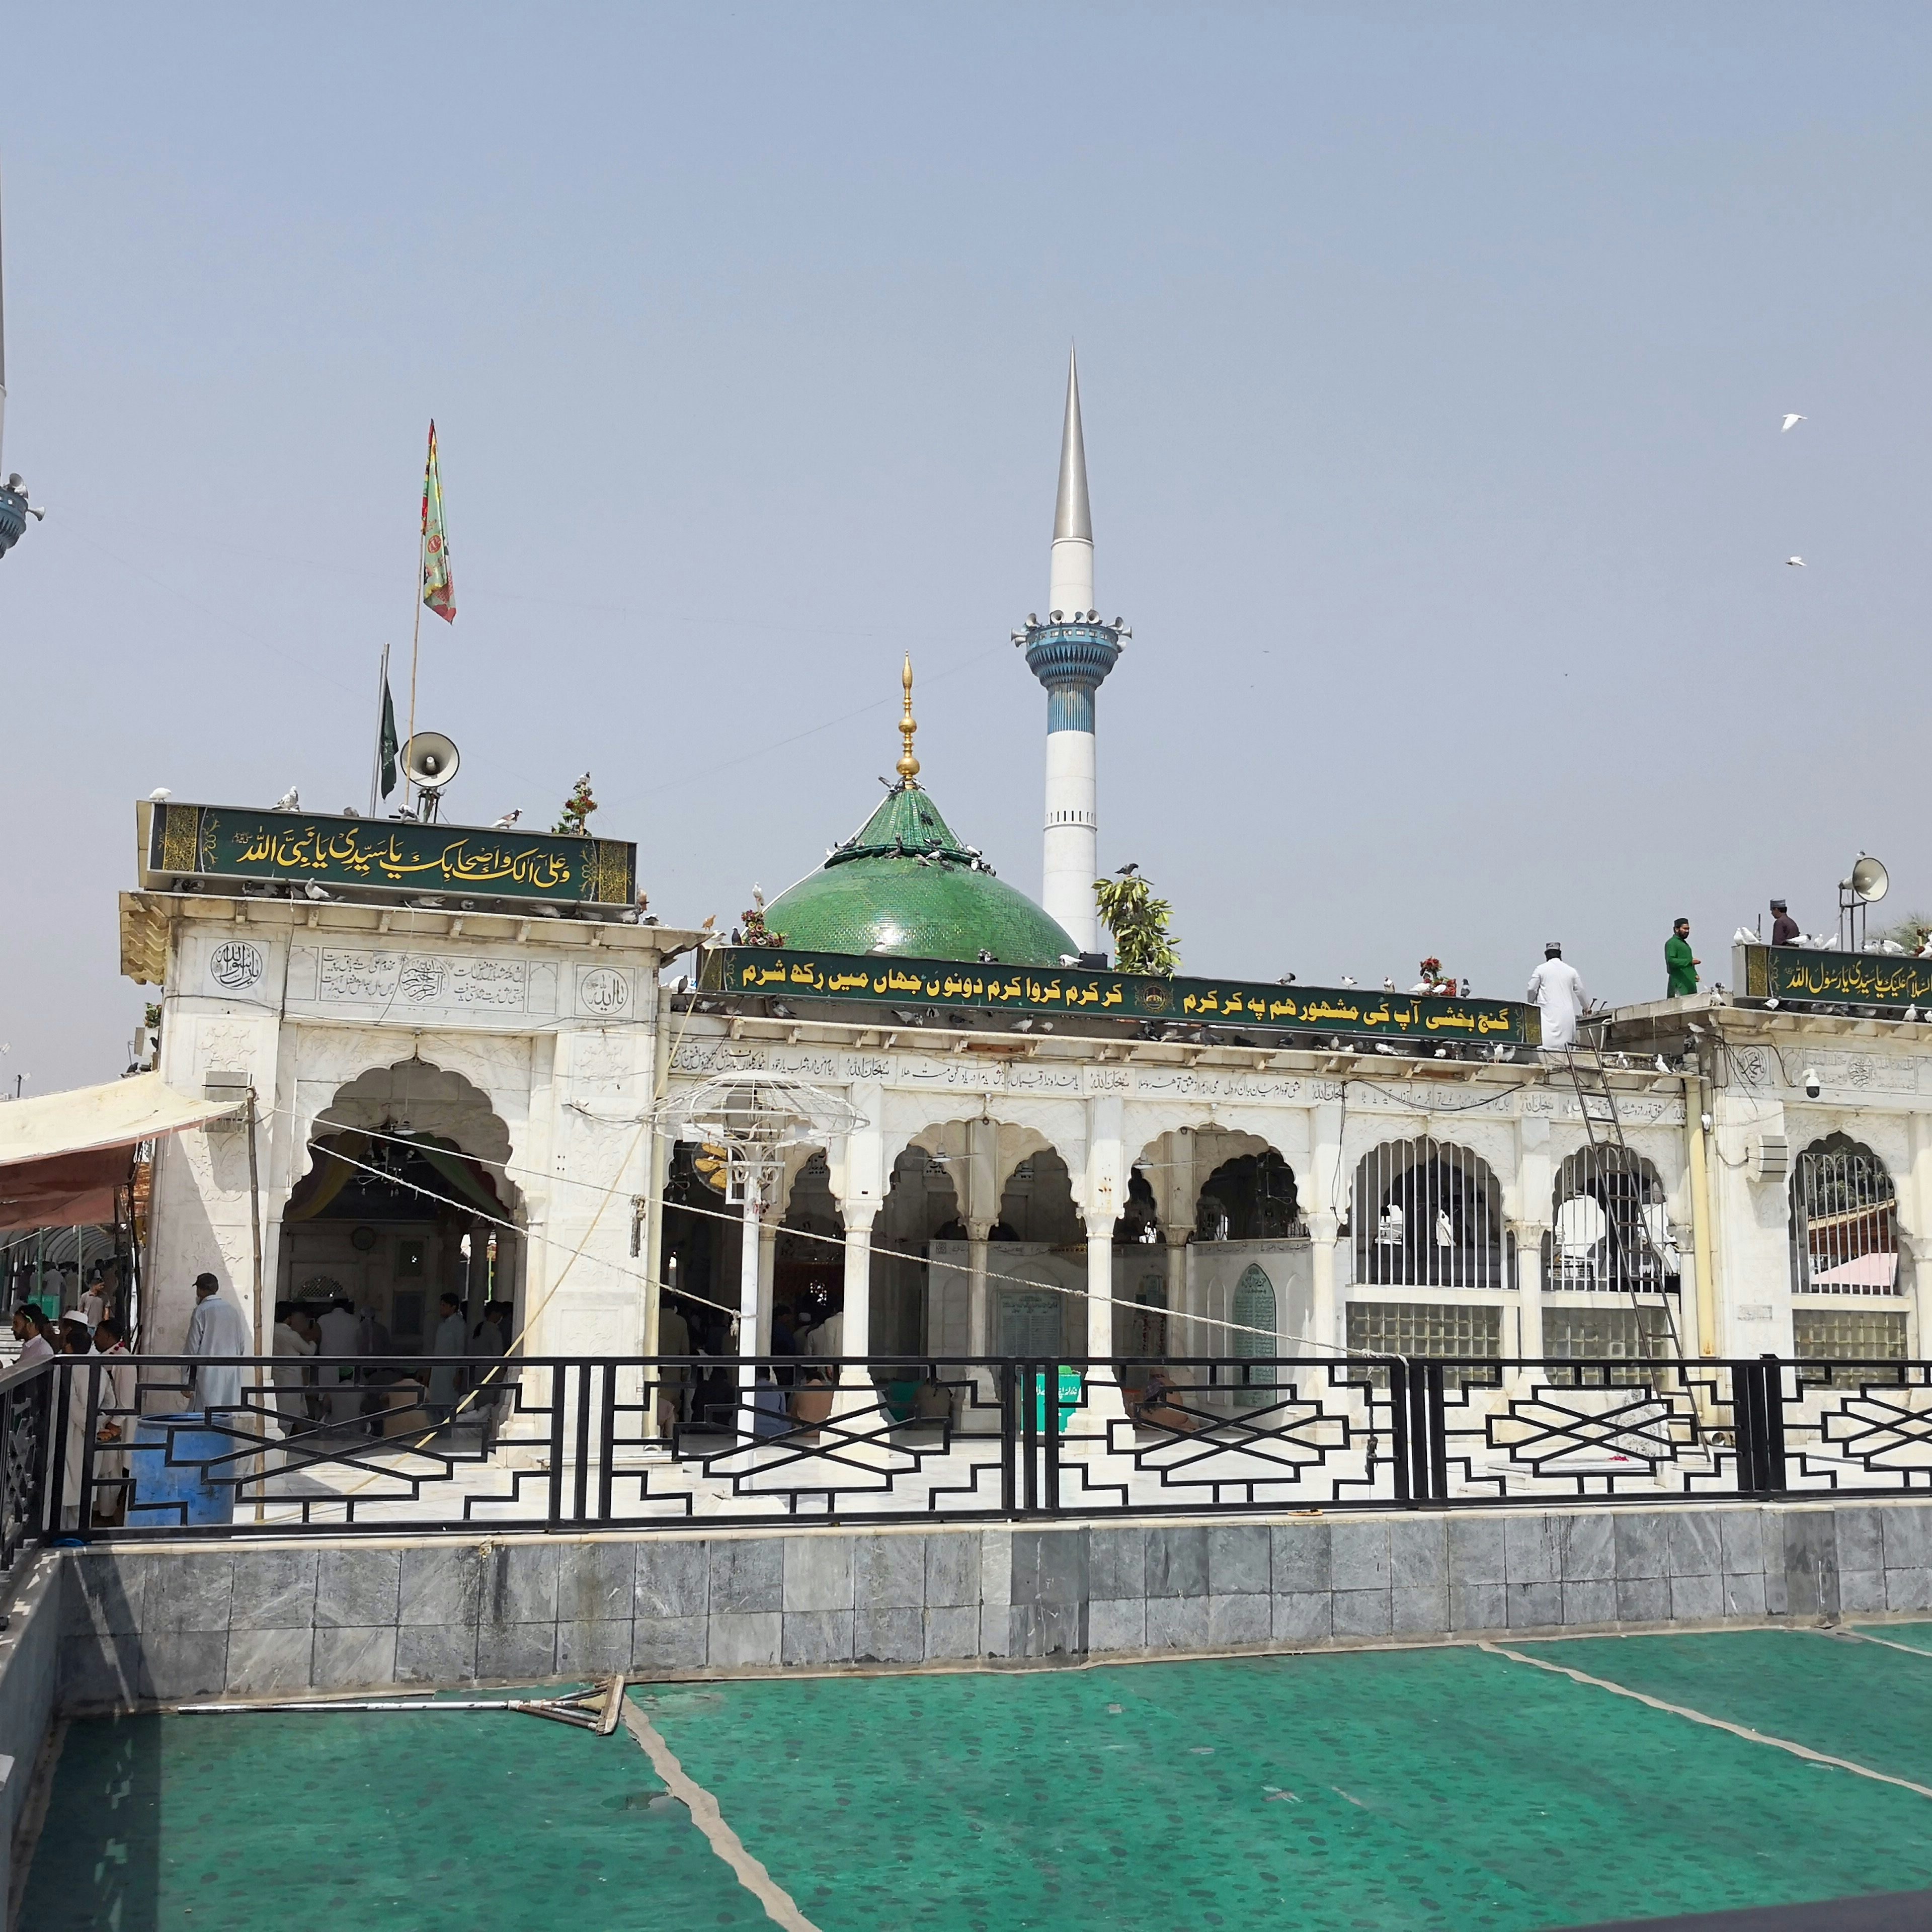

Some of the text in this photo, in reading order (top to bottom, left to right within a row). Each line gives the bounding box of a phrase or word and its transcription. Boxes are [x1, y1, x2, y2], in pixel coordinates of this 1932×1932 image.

[742, 959, 786, 987] شرم
[828, 972, 869, 991] میں
[926, 972, 983, 998] دونوں
[987, 976, 1022, 1002] کرم
[1026, 977, 1061, 1003] کروا
[1065, 982, 1099, 1006] کرم
[1101, 983, 1123, 1007] کر
[1183, 990, 1219, 1014] کرم
[1220, 991, 1243, 1015] کر
[1363, 1003, 1390, 1025] کی
[1393, 999, 1422, 1031] آپ
[1425, 1006, 1475, 1032] بخشی
[1478, 1007, 1509, 1033] گنج
